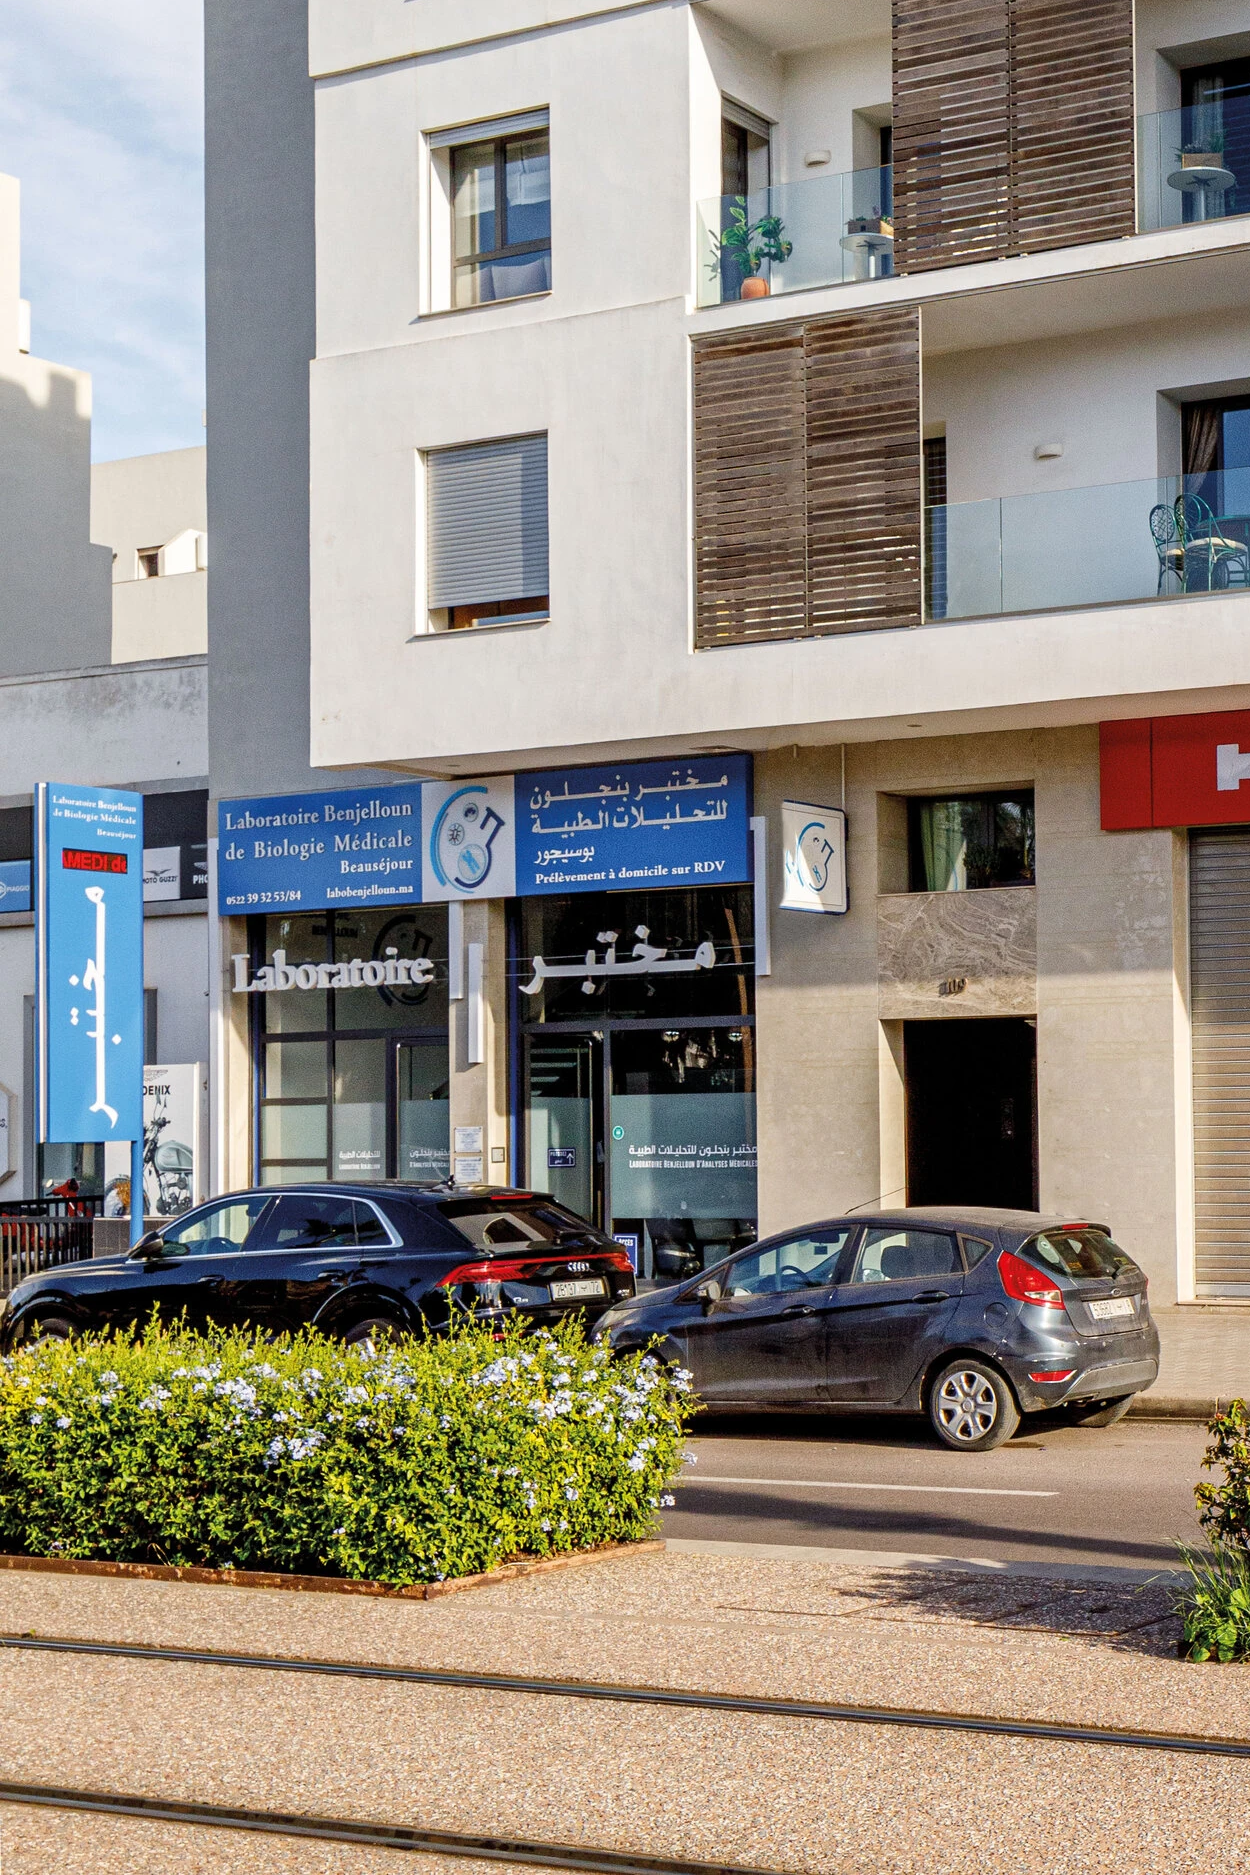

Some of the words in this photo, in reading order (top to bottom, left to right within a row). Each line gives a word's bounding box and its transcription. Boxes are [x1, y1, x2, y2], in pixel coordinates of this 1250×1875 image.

[530, 775, 629, 810] بنجلون
[635, 769, 728, 800] مختبر
[53, 795, 97, 809] Laboratoire
[97, 799, 137, 813] Benjelloun
[53, 808, 63, 817] de
[64, 809, 99, 822] Biologie
[100, 812, 137, 825] Médicale
[225, 808, 320, 831] Laboratoire
[324, 800, 412, 826] Benjelloun
[531, 811, 609, 838] الطبية
[612, 799, 728, 830] للتحليلات
[97, 828, 137, 841] Beauséjour
[225, 842, 245, 861] de
[254, 838, 325, 861] Biologie
[334, 830, 412, 853] Médicale
[534, 845, 595, 865] بوسيجور
[340, 858, 413, 875] Beauséjour
[535, 871, 606, 885] Prélèvement
[608, 868, 616, 879] à
[618, 864, 669, 879] domicile
[671, 865, 691, 875] sur
[694, 860, 726, 873] RDV
[6, 885, 30, 893] PIAGGIO
[160, 875, 179, 883] GUZZI
[226, 896, 245, 906] 0522
[247, 892, 258, 904] 39
[260, 892, 272, 904] 32
[273, 889, 301, 903] 53/84
[326, 884, 414, 900] labobenjelloun.ma
[231, 946, 434, 993] Laboratoire
[518, 925, 716, 994] مختبر
[628, 1145, 656, 1156] الطبية
